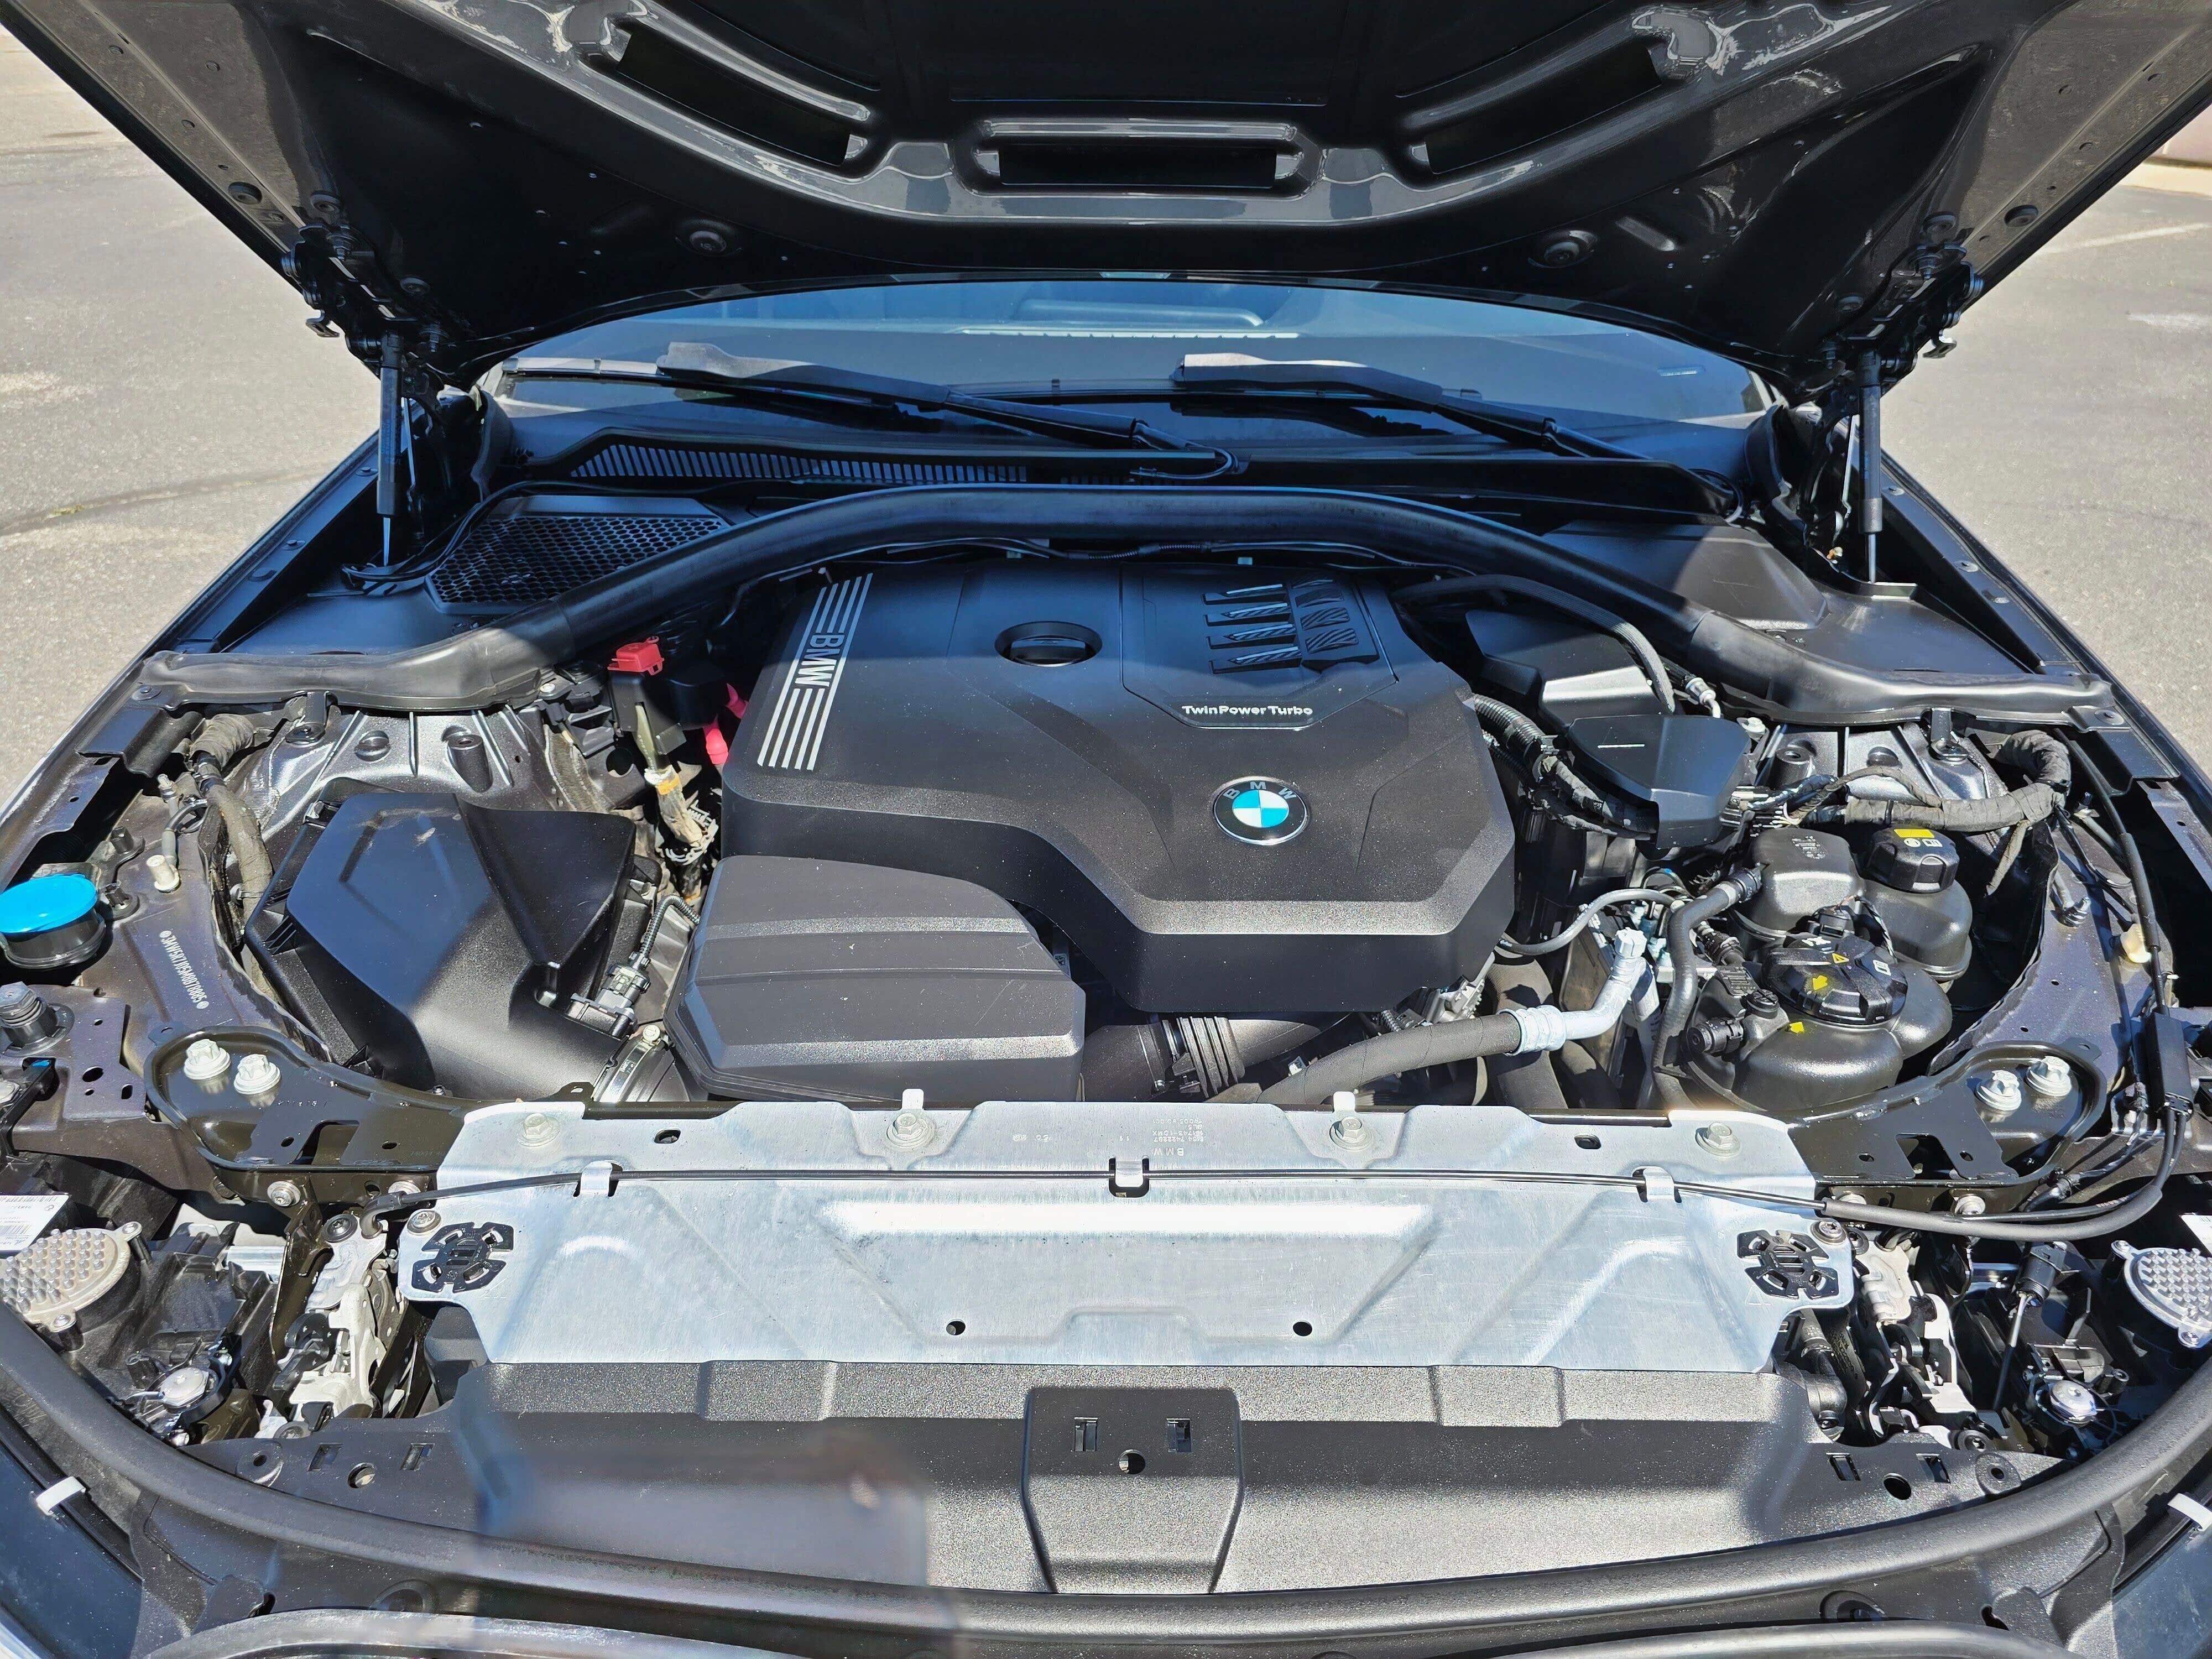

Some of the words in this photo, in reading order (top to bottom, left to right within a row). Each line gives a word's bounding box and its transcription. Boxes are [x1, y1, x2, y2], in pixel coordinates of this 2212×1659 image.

[794, 634, 845, 687] BMW
[1181, 705, 1266, 715] TwinPower
[1267, 705, 1313, 715] Turbo
[1223, 780, 1297, 800] BMW
